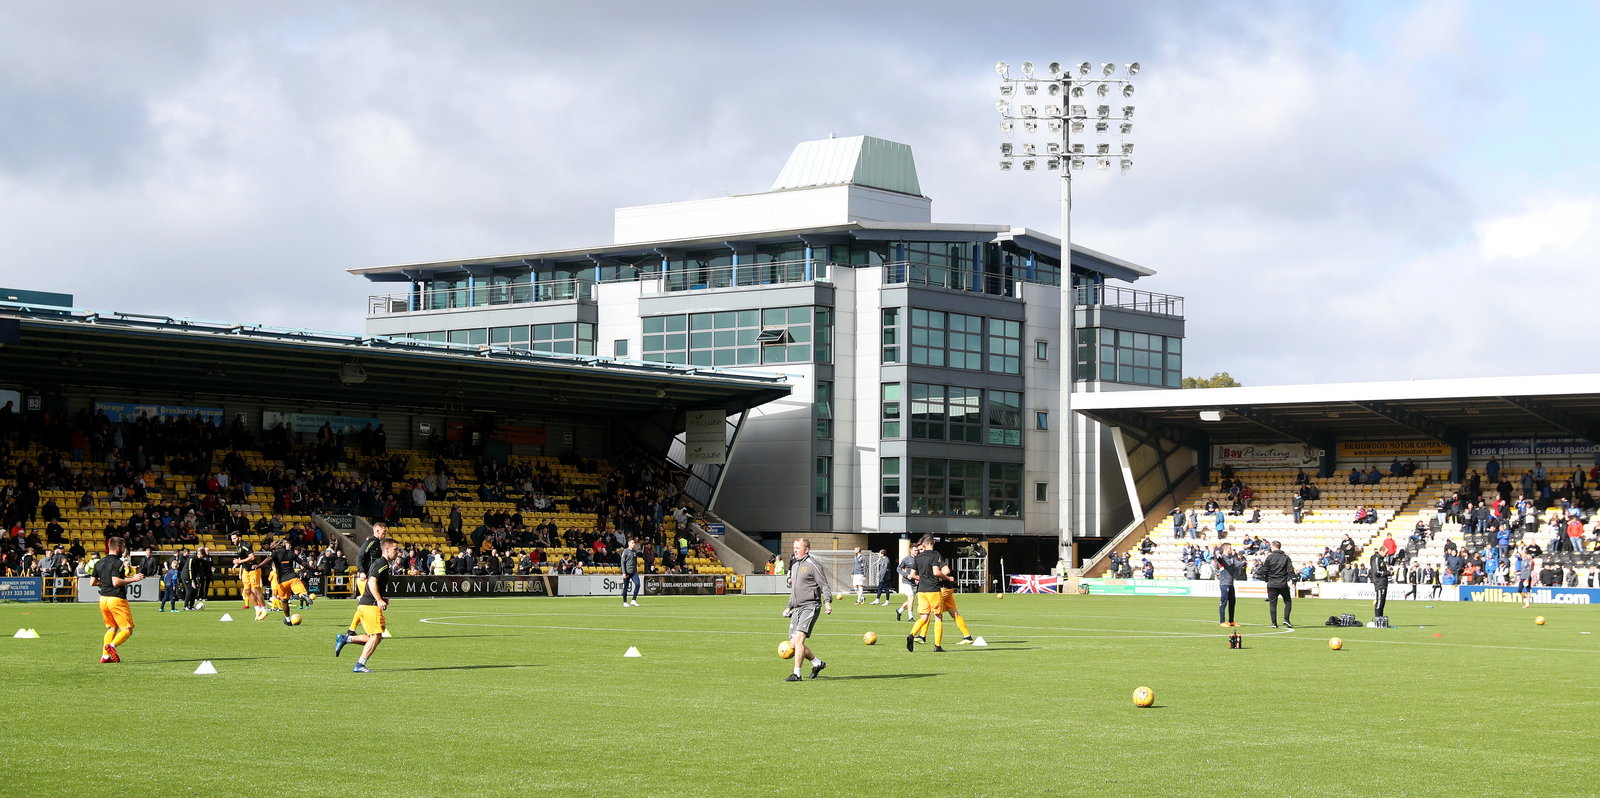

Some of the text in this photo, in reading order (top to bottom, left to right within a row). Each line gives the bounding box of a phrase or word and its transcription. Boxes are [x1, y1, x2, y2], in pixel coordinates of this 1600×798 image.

[160, 406, 193, 415] Broxburn
[1344, 440, 1449, 450] BRAIDWOOD MOTOR COMPA
[1223, 447, 1243, 458] Bay
[1472, 447, 1529, 455] 01506 884040
[1536, 446, 1595, 454] 01506 884040
[406, 580, 490, 593] MACARONI
[494, 580, 543, 592] ARENA
